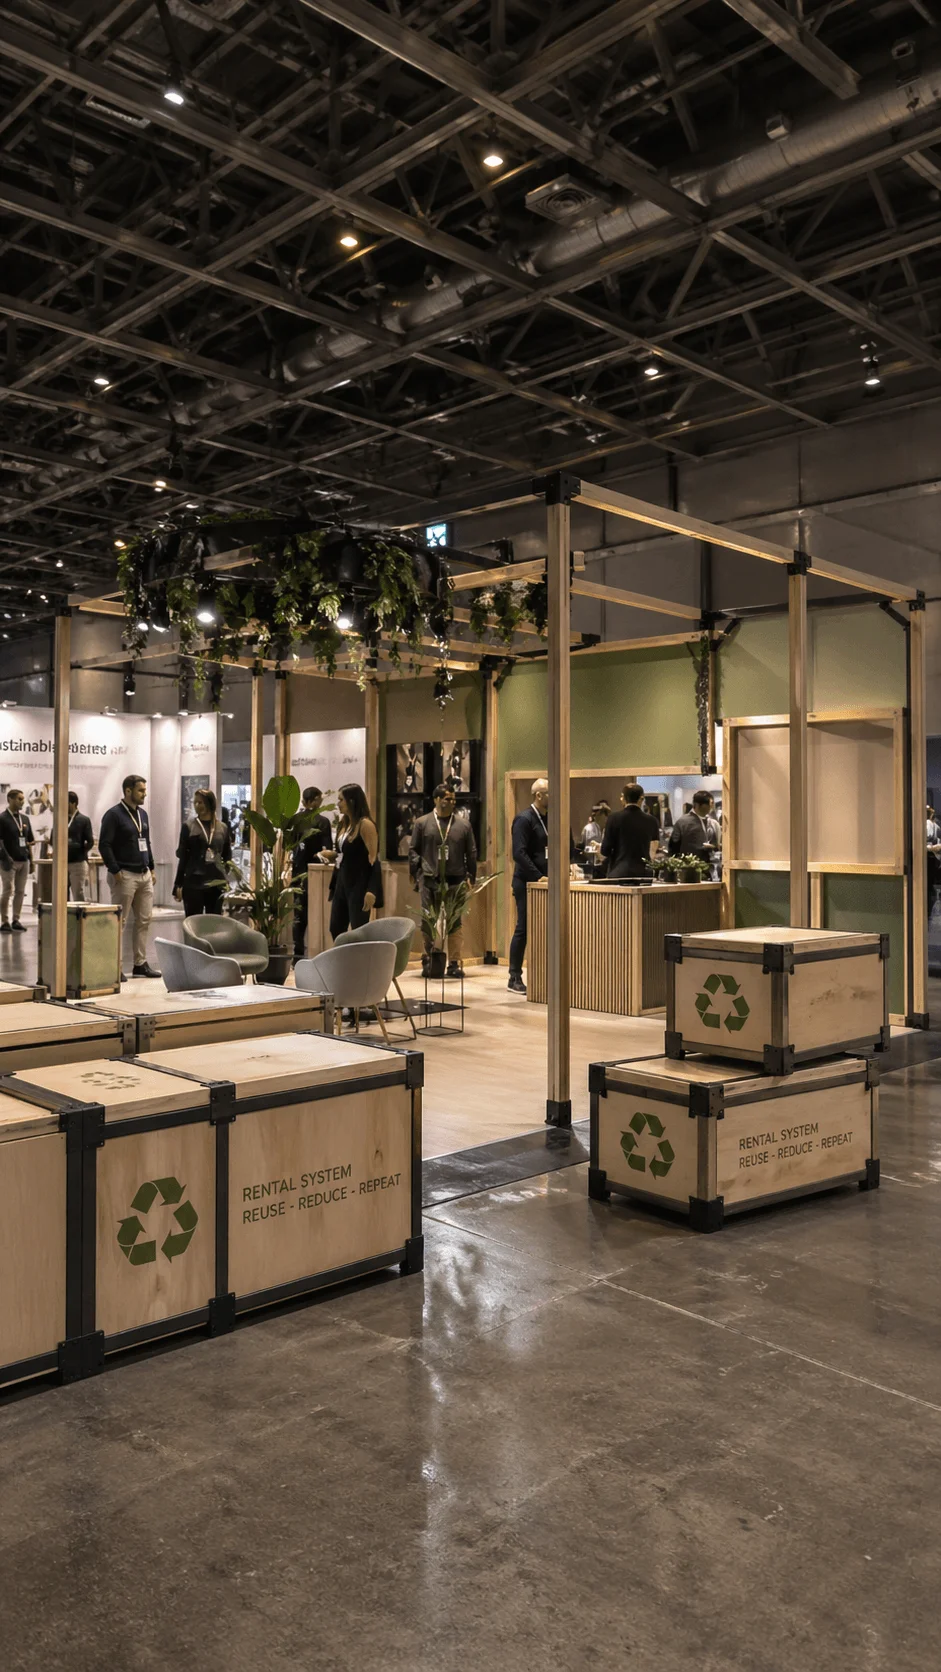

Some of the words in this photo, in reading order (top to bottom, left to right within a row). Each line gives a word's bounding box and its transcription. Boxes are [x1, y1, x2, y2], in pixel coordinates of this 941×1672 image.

[738, 1132, 778, 1150] RENTAL
[781, 1122, 819, 1141] SYSTEM
[739, 1151, 769, 1169] REUSE
[777, 1141, 813, 1159] REDUCE
[821, 1132, 853, 1149] REPEAT
[242, 1178, 297, 1202] RENTAL
[301, 1164, 352, 1188] SYSTEM
[242, 1201, 286, 1224] REUSE
[298, 1186, 348, 1210] REDUCE
[359, 1173, 401, 1195] REPEAT
